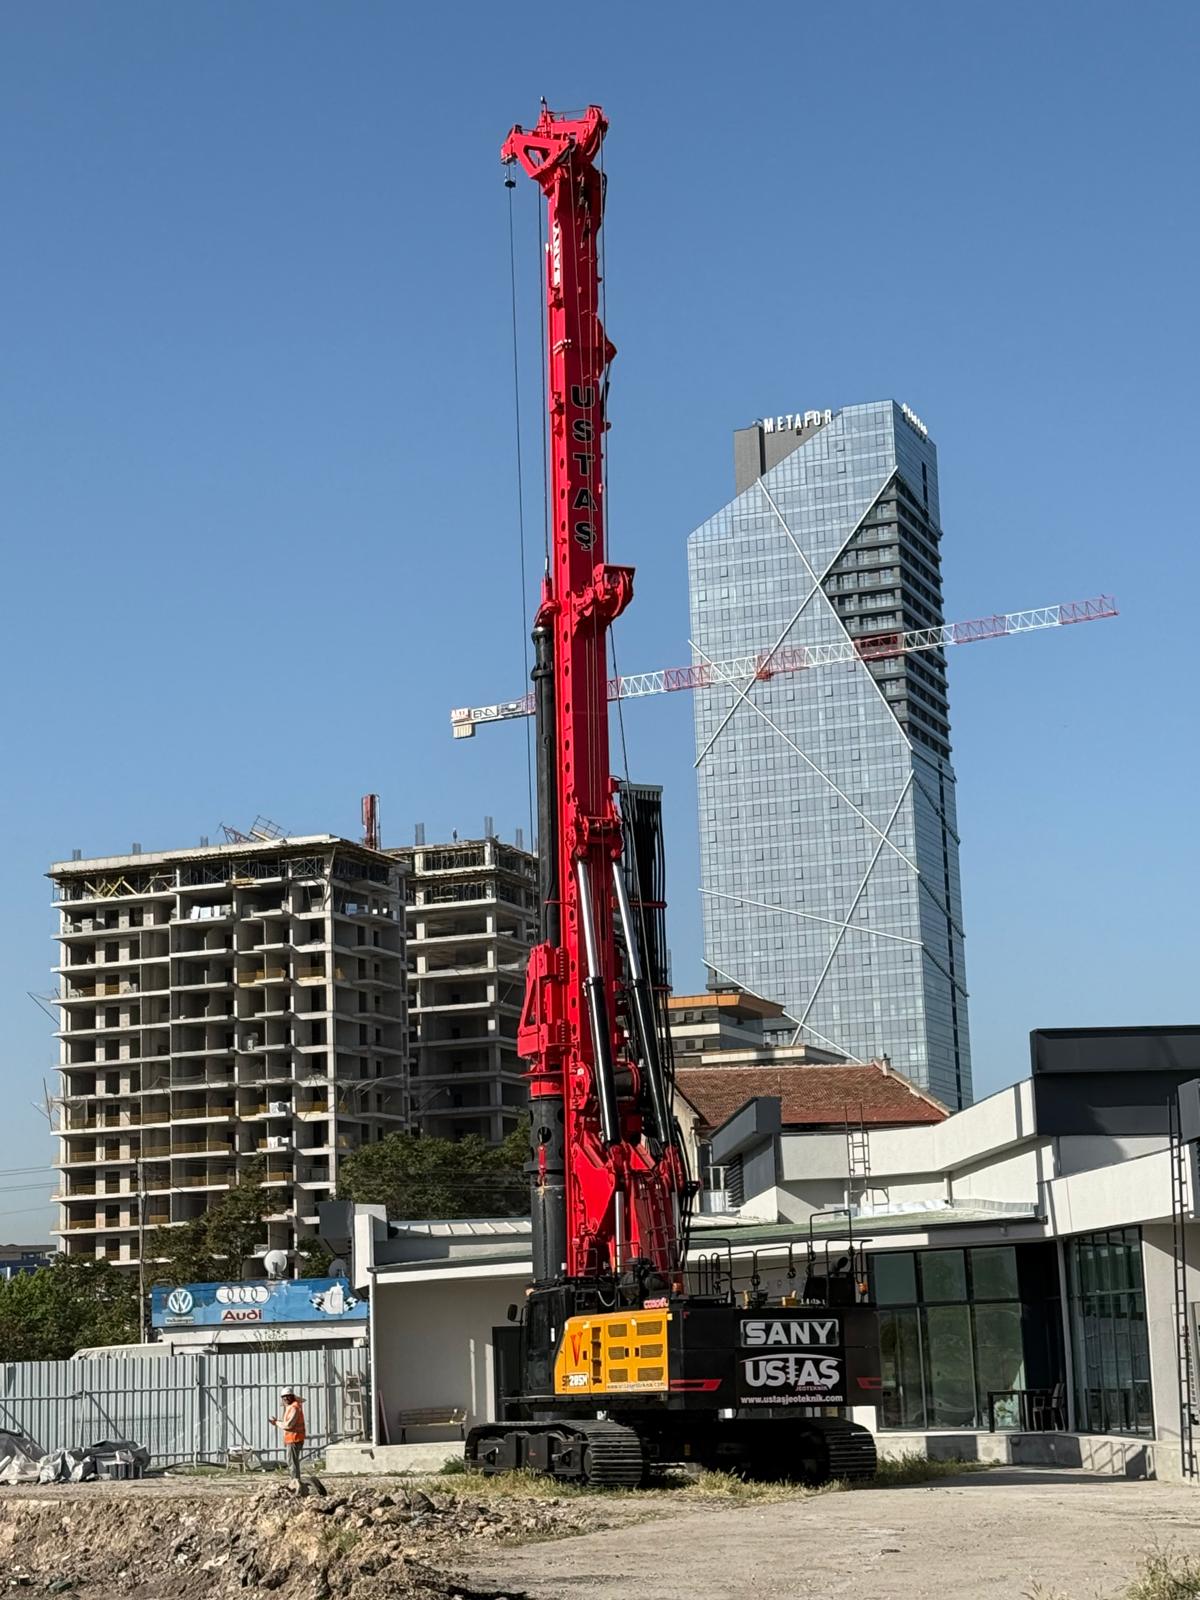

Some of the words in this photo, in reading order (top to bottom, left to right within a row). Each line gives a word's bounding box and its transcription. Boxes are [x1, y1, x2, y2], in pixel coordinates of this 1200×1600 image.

[763, 409, 832, 434] METAFOR
[222, 1309, 262, 1321] Audi
[745, 1321, 834, 1345] SANY
